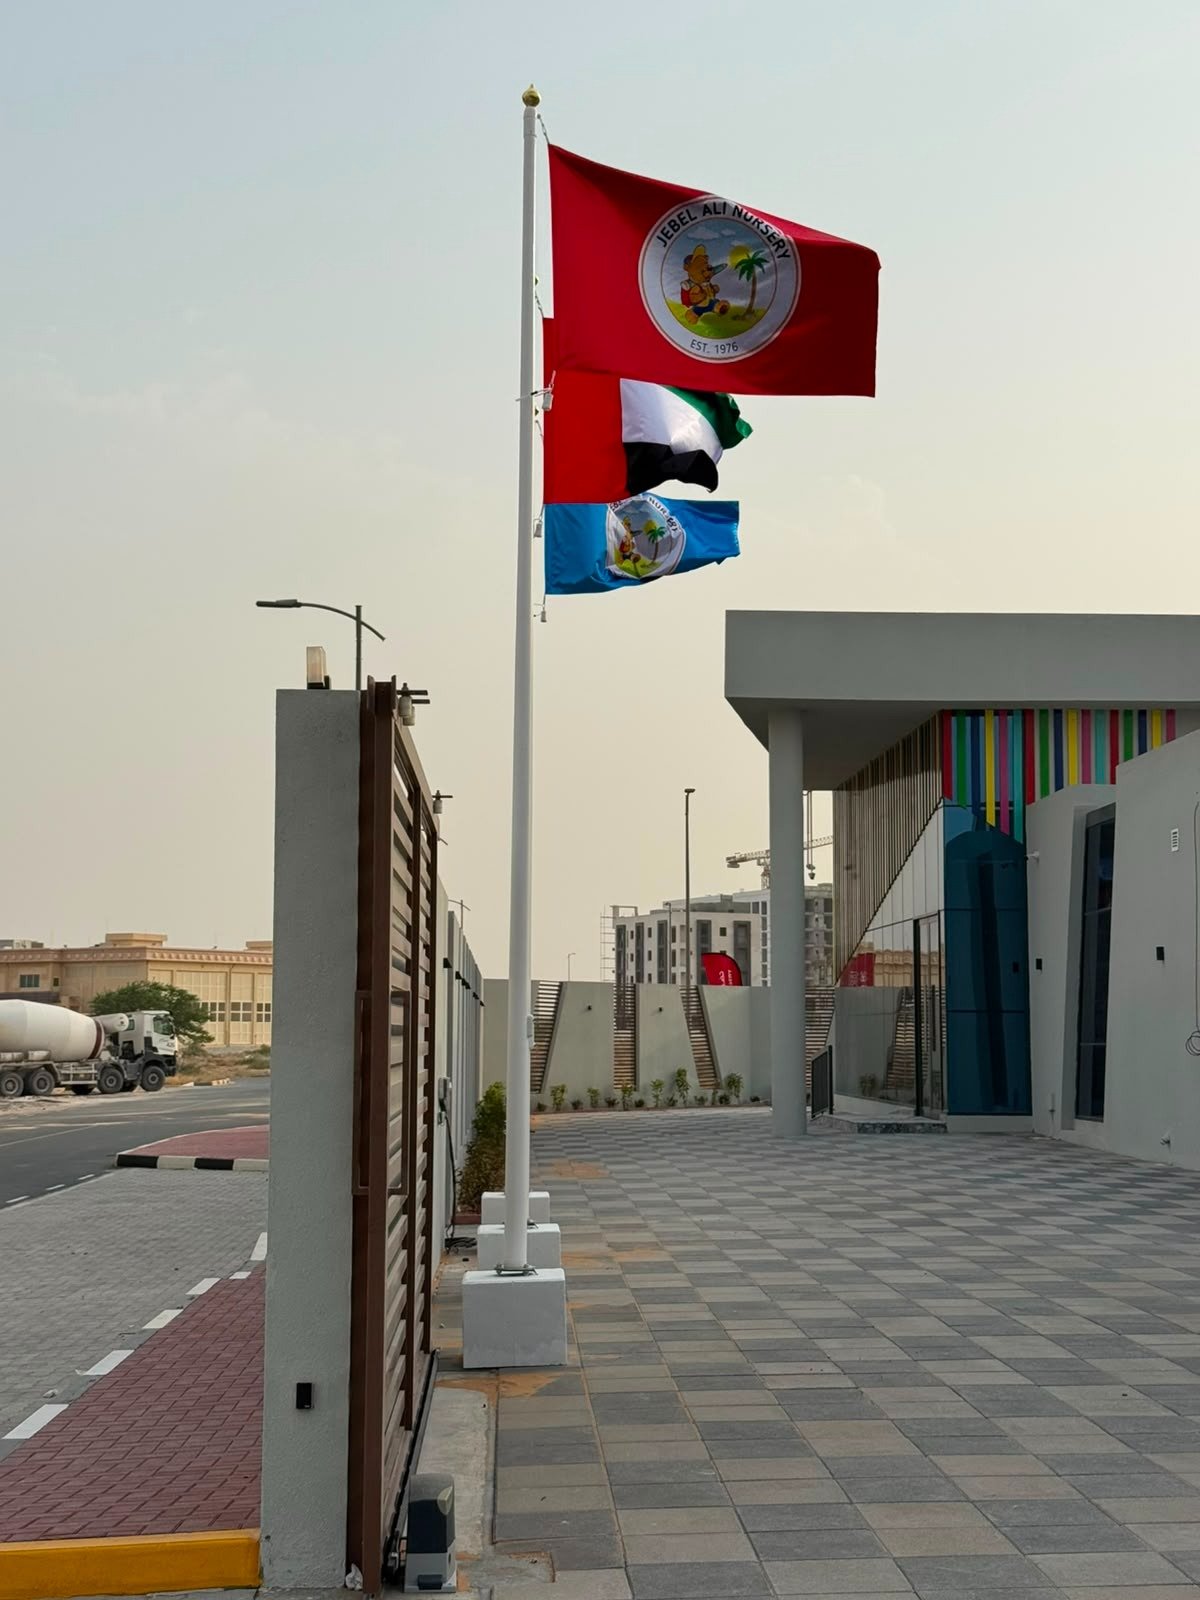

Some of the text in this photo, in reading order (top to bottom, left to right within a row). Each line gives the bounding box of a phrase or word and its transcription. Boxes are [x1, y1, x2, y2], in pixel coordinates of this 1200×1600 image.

[656, 201, 790, 259] JEBEL ALI NURSERY
[690, 339, 739, 354] EST. 1976
